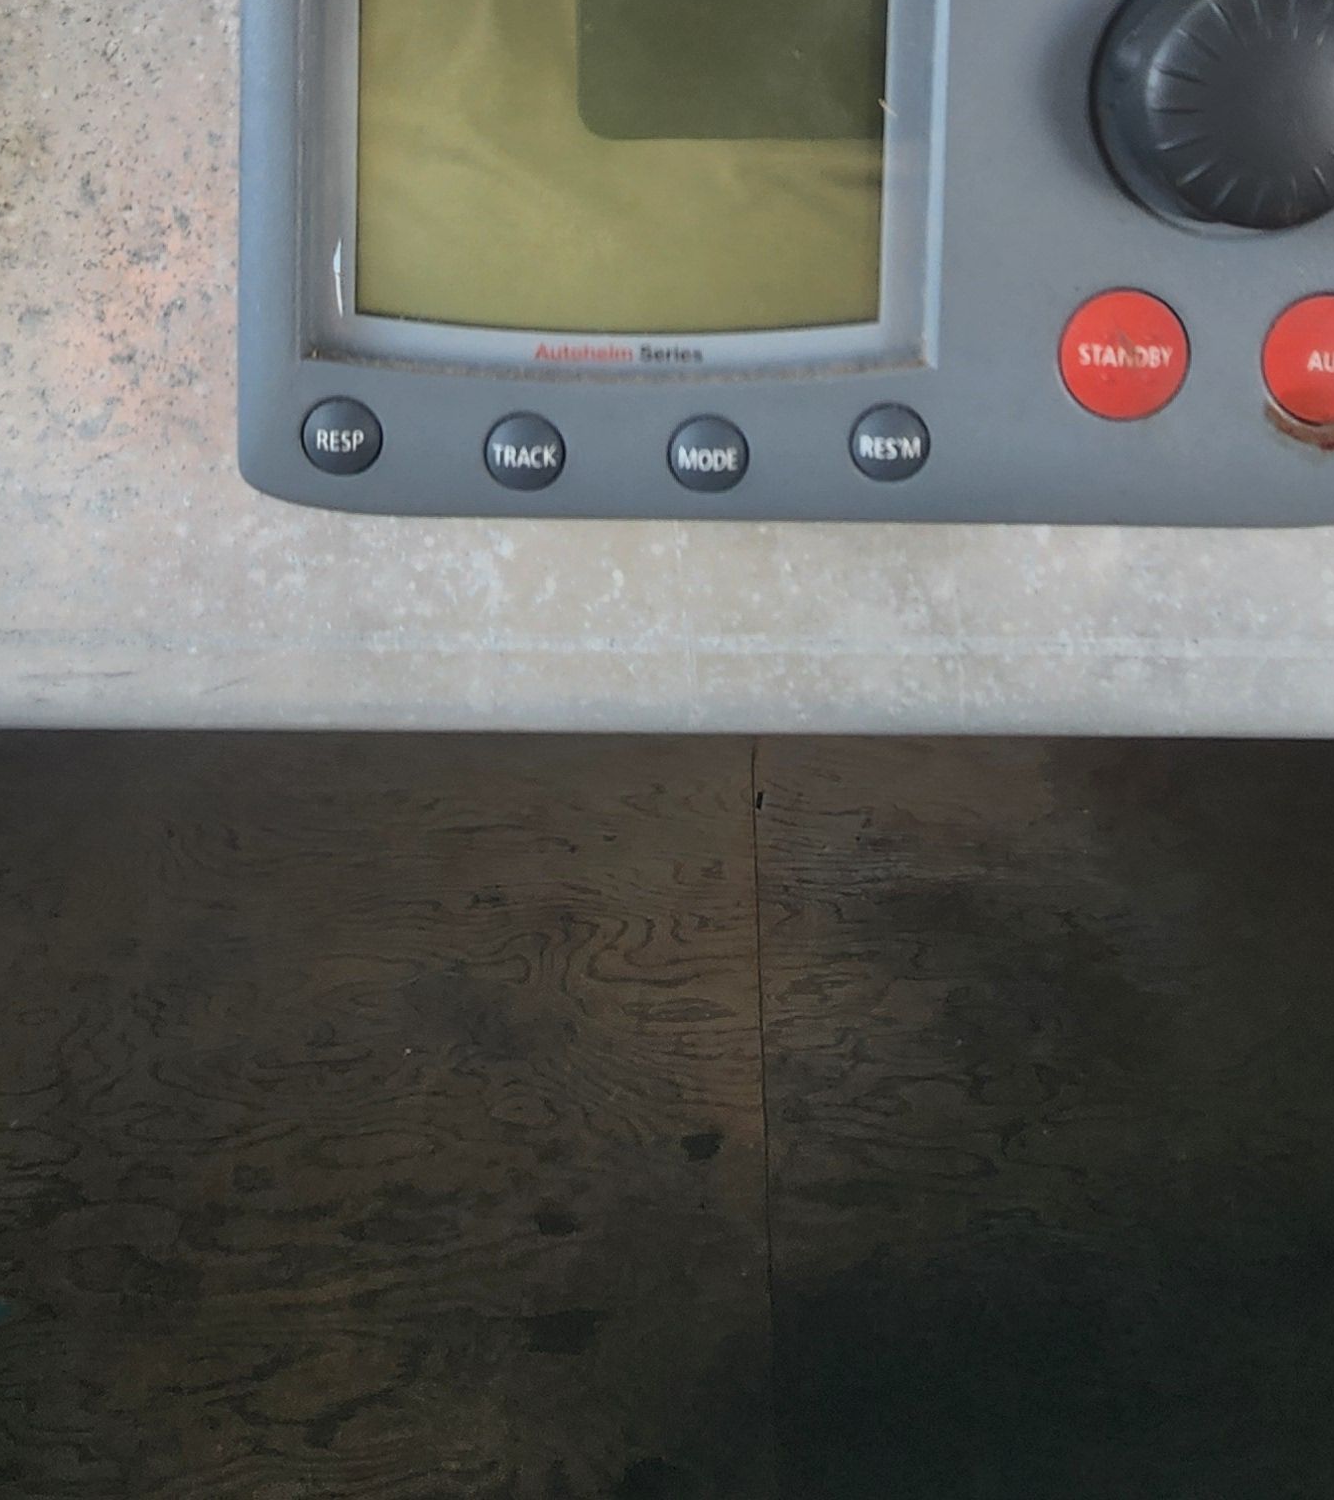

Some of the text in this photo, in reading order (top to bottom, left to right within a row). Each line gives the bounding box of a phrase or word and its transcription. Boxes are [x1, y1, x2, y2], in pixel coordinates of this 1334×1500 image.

[639, 343, 703, 363] Series
[1078, 343, 1172, 368] STANDBY
[316, 429, 364, 452] RESP
[492, 443, 557, 468] TRACK
[677, 445, 738, 472] MODE
